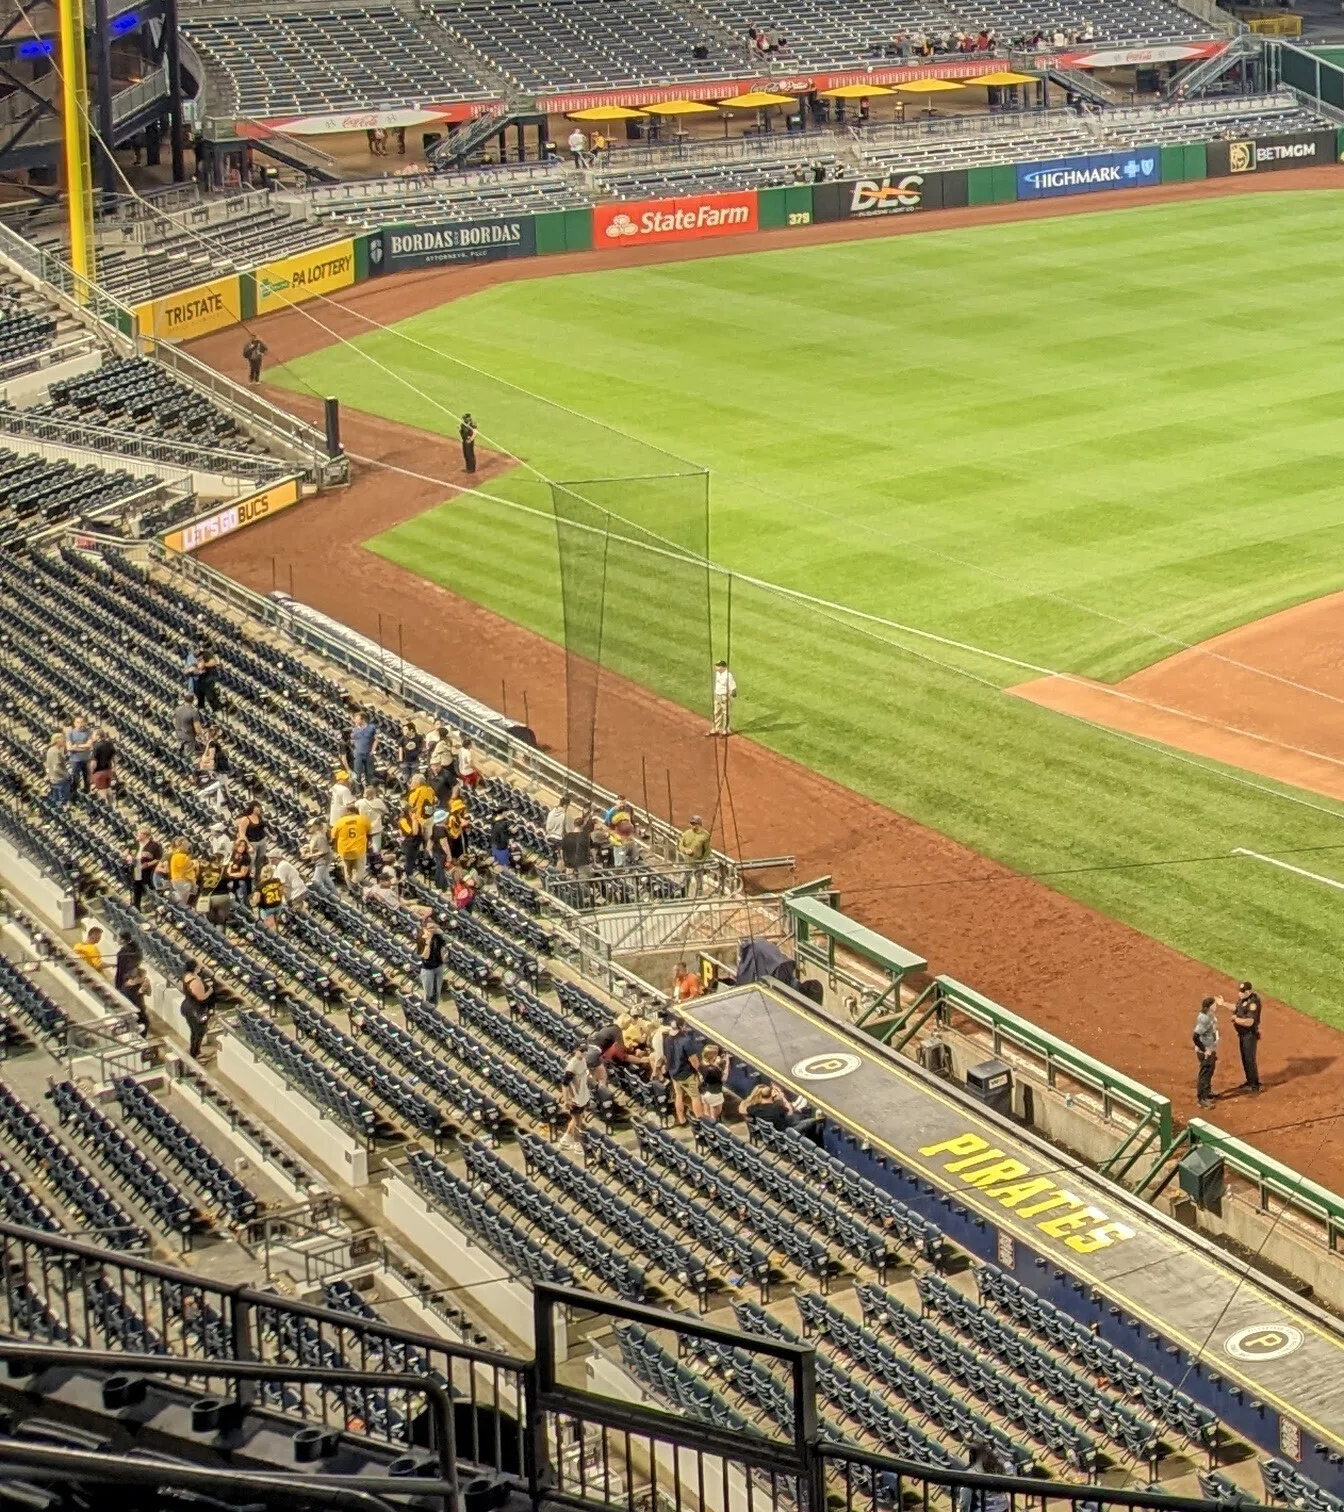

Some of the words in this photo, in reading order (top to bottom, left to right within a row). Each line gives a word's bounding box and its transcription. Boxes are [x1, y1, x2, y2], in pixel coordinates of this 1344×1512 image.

[1257, 142, 1316, 162] BETMGM
[1035, 164, 1122, 190] HIGHMARK
[851, 175, 924, 211] DLC
[391, 230, 454, 254] BORDAS
[459, 223, 521, 247] BORDAS
[291, 269, 306, 289] PA
[306, 255, 353, 287] LOTTERY
[165, 292, 224, 327] TRISTATE
[238, 497, 270, 525] BUCS
[917, 1132, 1137, 1254] PIRATES
[1244, 1333, 1283, 1347] P
